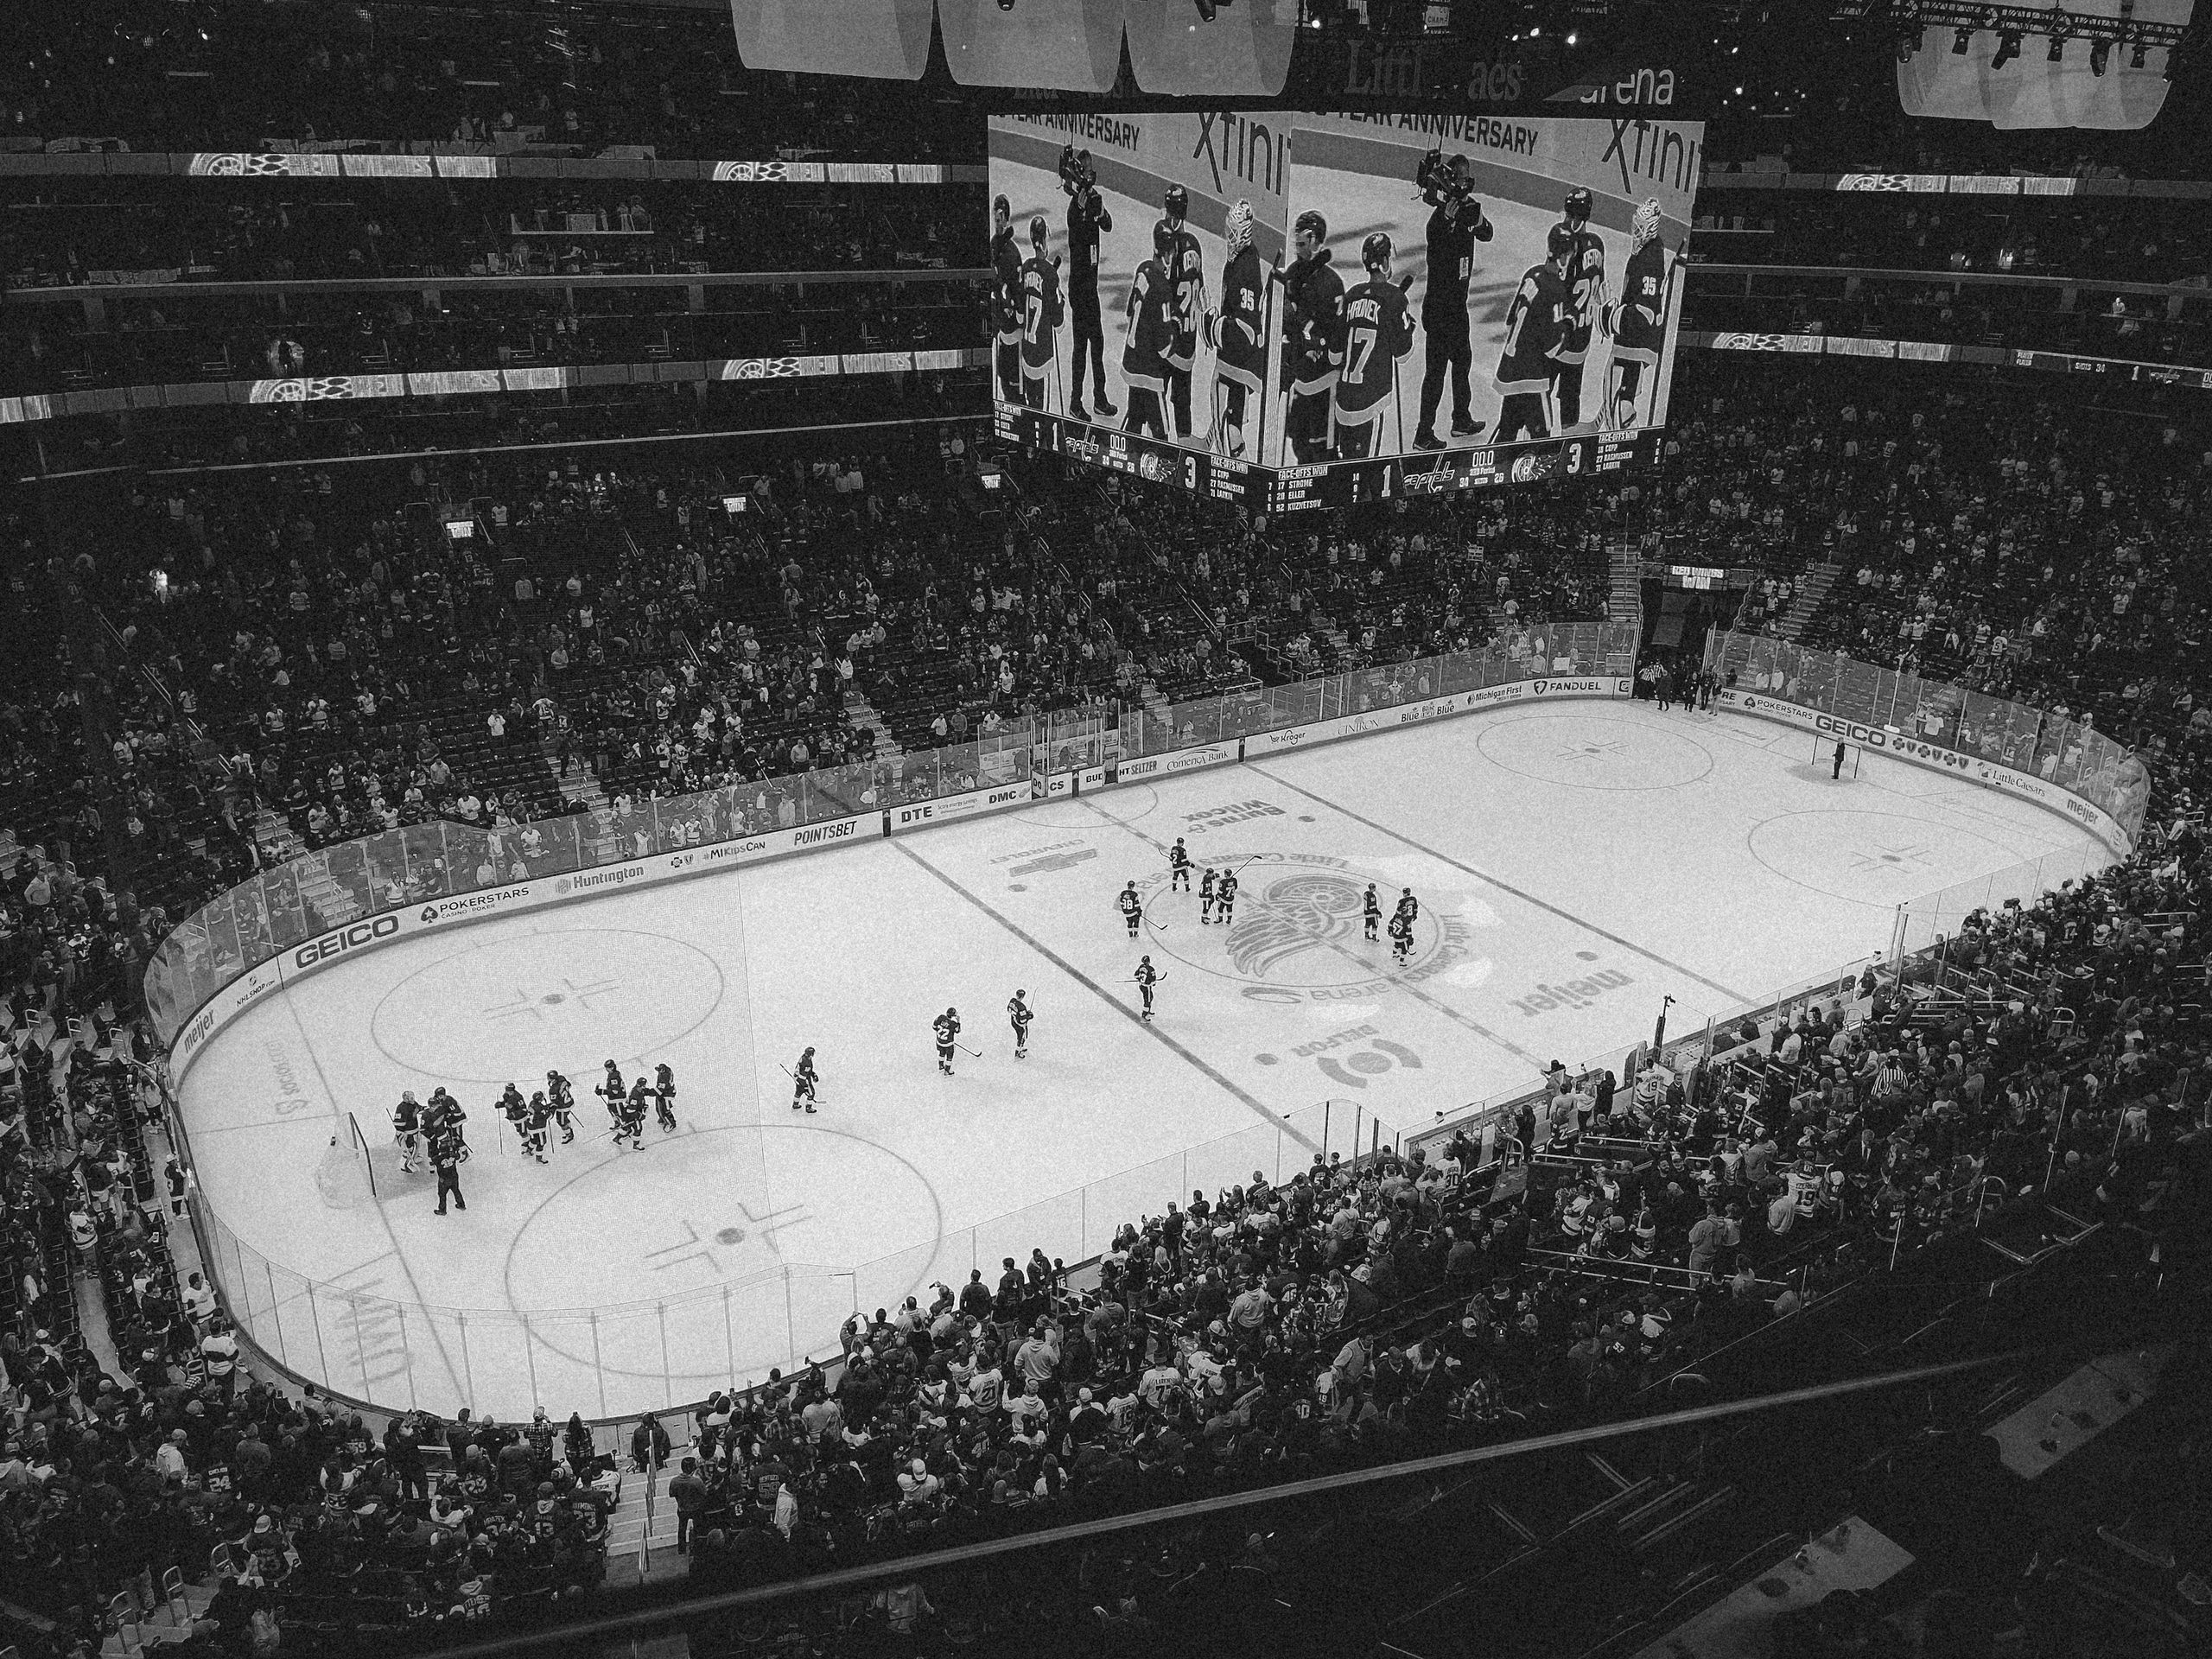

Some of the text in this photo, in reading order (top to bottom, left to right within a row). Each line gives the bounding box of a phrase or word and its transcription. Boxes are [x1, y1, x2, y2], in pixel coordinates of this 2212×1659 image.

[1642, 276, 1656, 296] 35
[1240, 288, 1255, 311] 35
[1342, 327, 1377, 384] 17
[2132, 365, 2139, 381] 1
[1052, 423, 1058, 452] 1
[1656, 437, 1662, 446] 7
[1472, 450, 1495, 467] 00.0
[1567, 442, 1582, 474] 3
[1185, 455, 1196, 489] 3
[1278, 467, 1312, 480] FACE-OFFS
[1494, 473, 1504, 484] 26
[1278, 482, 1285, 491] 17
[1288, 479, 1313, 490] STROME
[1382, 465, 1391, 498] 1
[1287, 490, 1306, 500] ELLER
[1275, 503, 1285, 512] 92
[1287, 499, 1322, 512] KUZNETSOV
[1691, 567, 1724, 579] WINGS
[1682, 575, 1711, 590] WIN
[1476, 685, 1522, 702] Michigan First
[1549, 681, 1602, 691] FANDUEL
[1401, 710, 1420, 723] Blue
[1437, 702, 1455, 715] Blue
[1758, 699, 1813, 720] POKERSTARS
[1281, 730, 1306, 745] Kroger
[1815, 715, 1885, 747] GEICO
[1208, 748, 1230, 762] Bank
[1130, 760, 1157, 776] SELTZER
[1993, 769, 2046, 797] Little Caesars
[988, 790, 1017, 804] DMC
[901, 805, 932, 823] DTE
[2067, 798, 2099, 824] meijer
[794, 820, 857, 846] POINTSBET
[574, 866, 645, 889] Huntington
[440, 887, 529, 913] POKERSTARS
[296, 915, 399, 969] GEICO
[1512, 969, 1635, 1018] meijer
[184, 1008, 215, 1054] meijer
[1648, 1079, 1658, 1092] 19
[1796, 1190, 1815, 1206] 19
[209, 1475, 232, 1493] 24
